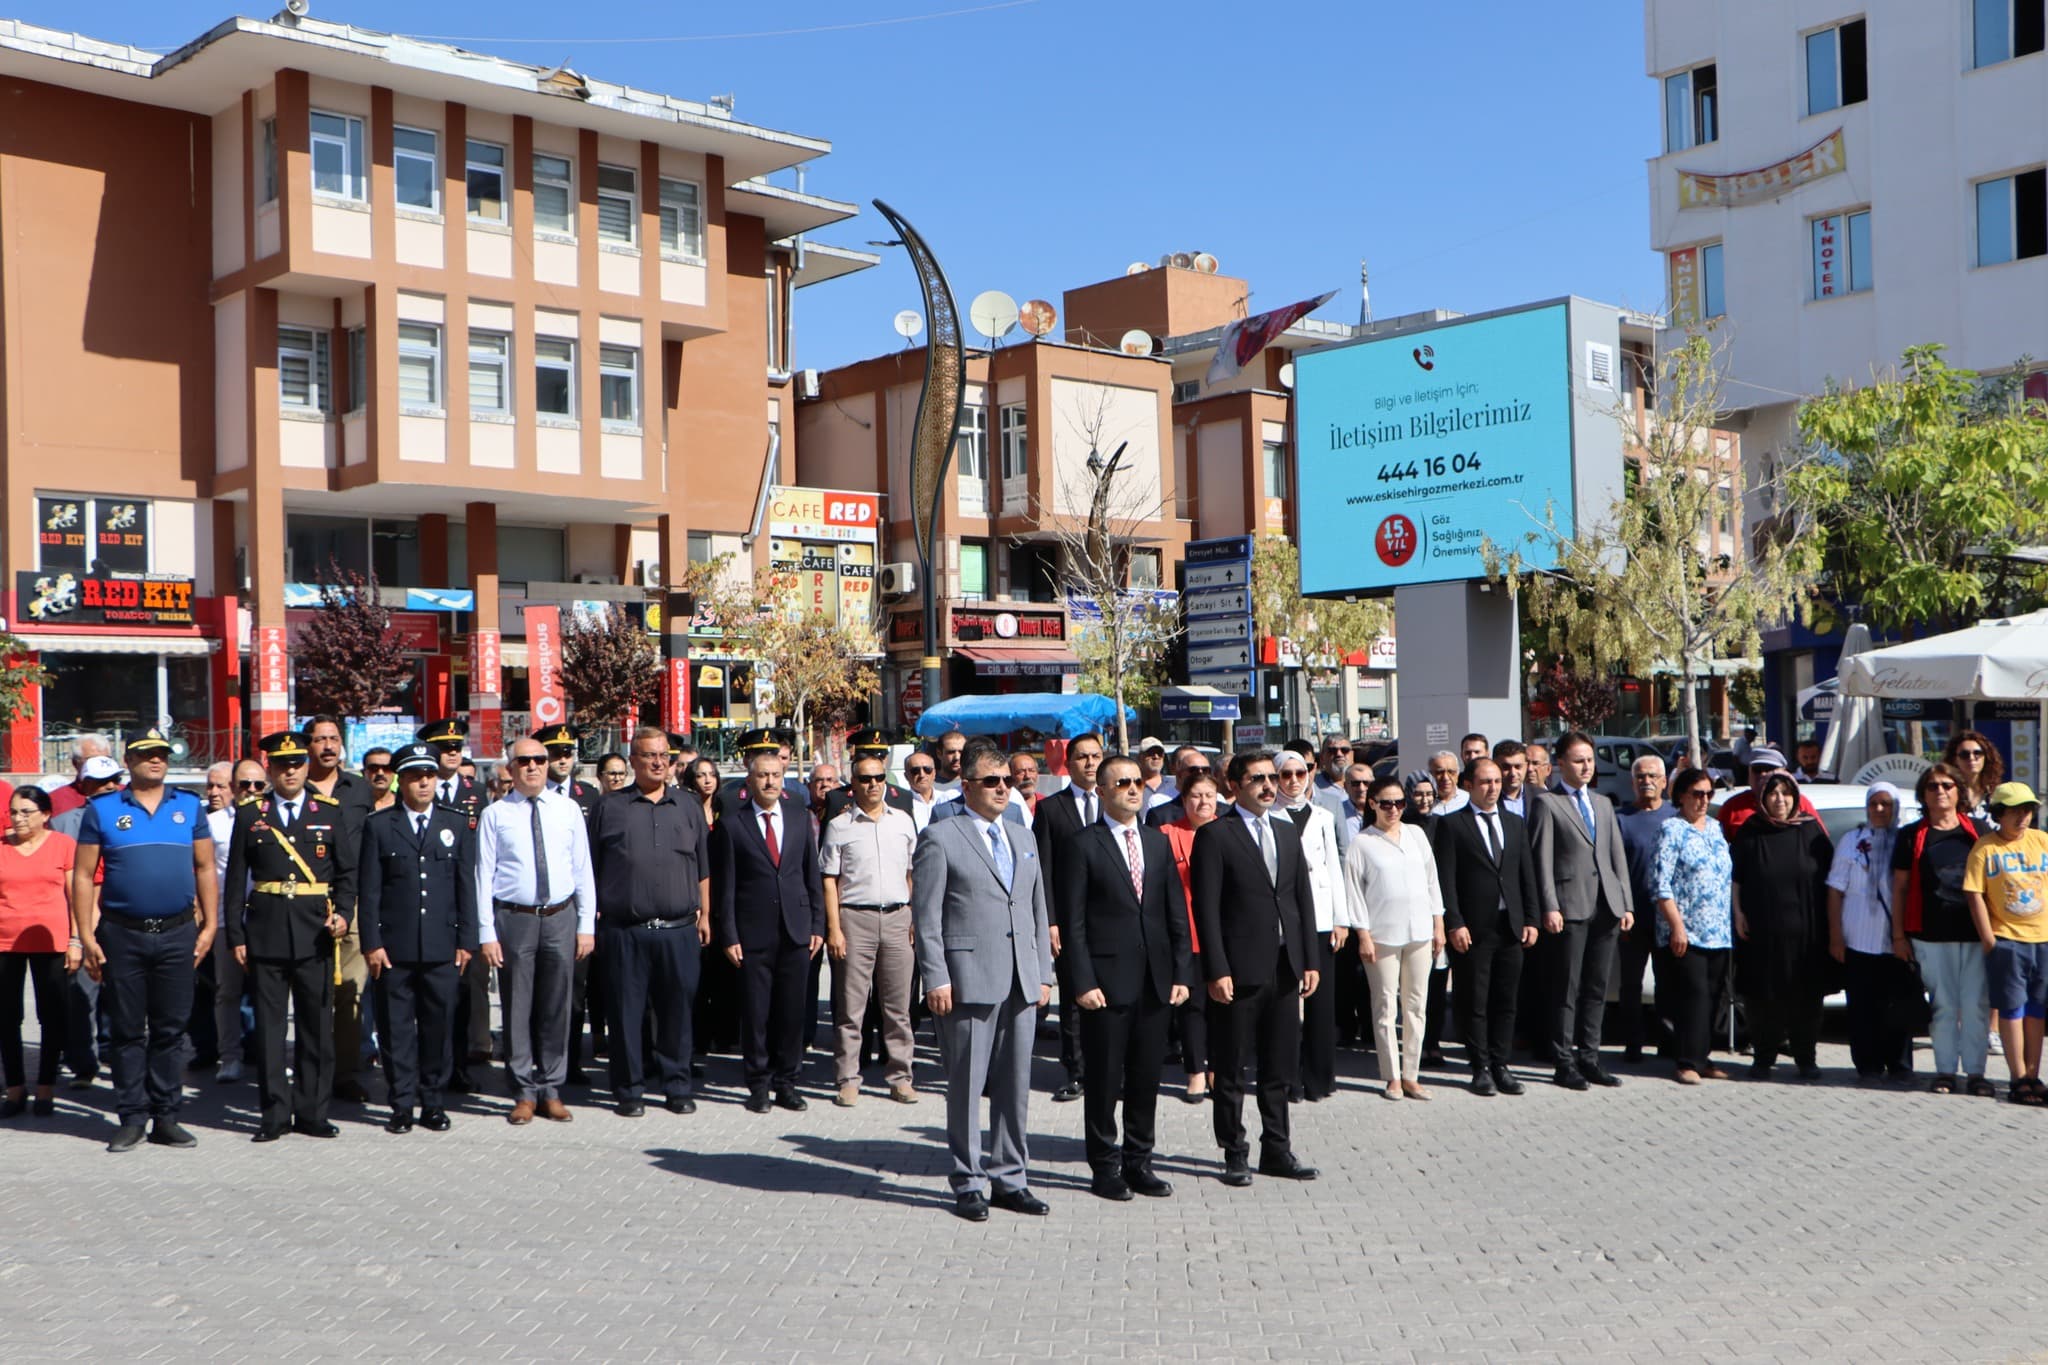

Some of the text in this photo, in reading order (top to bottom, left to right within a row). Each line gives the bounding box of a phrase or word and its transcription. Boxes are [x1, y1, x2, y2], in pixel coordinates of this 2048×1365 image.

[1821, 218, 1835, 295] 1. NOTER
[1375, 394, 1396, 412] Bilgi
[1399, 394, 1412, 405] ve
[1330, 398, 1532, 451] İletişim Bilgilerimiz
[1377, 451, 1481, 483] 444 16 04
[1346, 474, 1525, 505] www.eskisehirgozmerkezi.com.tr
[773, 501, 872, 522] CAFE RED
[1431, 514, 1451, 525] Göz
[40, 532, 62, 544] RED
[99, 532, 121, 544] RED
[802, 557, 833, 570] CAFE
[843, 565, 872, 577] CAFE
[844, 581, 870, 592] RED
[1189, 574, 1212, 584] Adliye
[83, 579, 140, 608] RED
[105, 610, 152, 620] TOBACCO
[268, 629, 282, 692] ZAFER
[484, 634, 497, 693] ZAFER
[537, 623, 553, 693] vodafone
[1190, 655, 1213, 665] Otogar
[1985, 852, 2048, 878] UCLA
